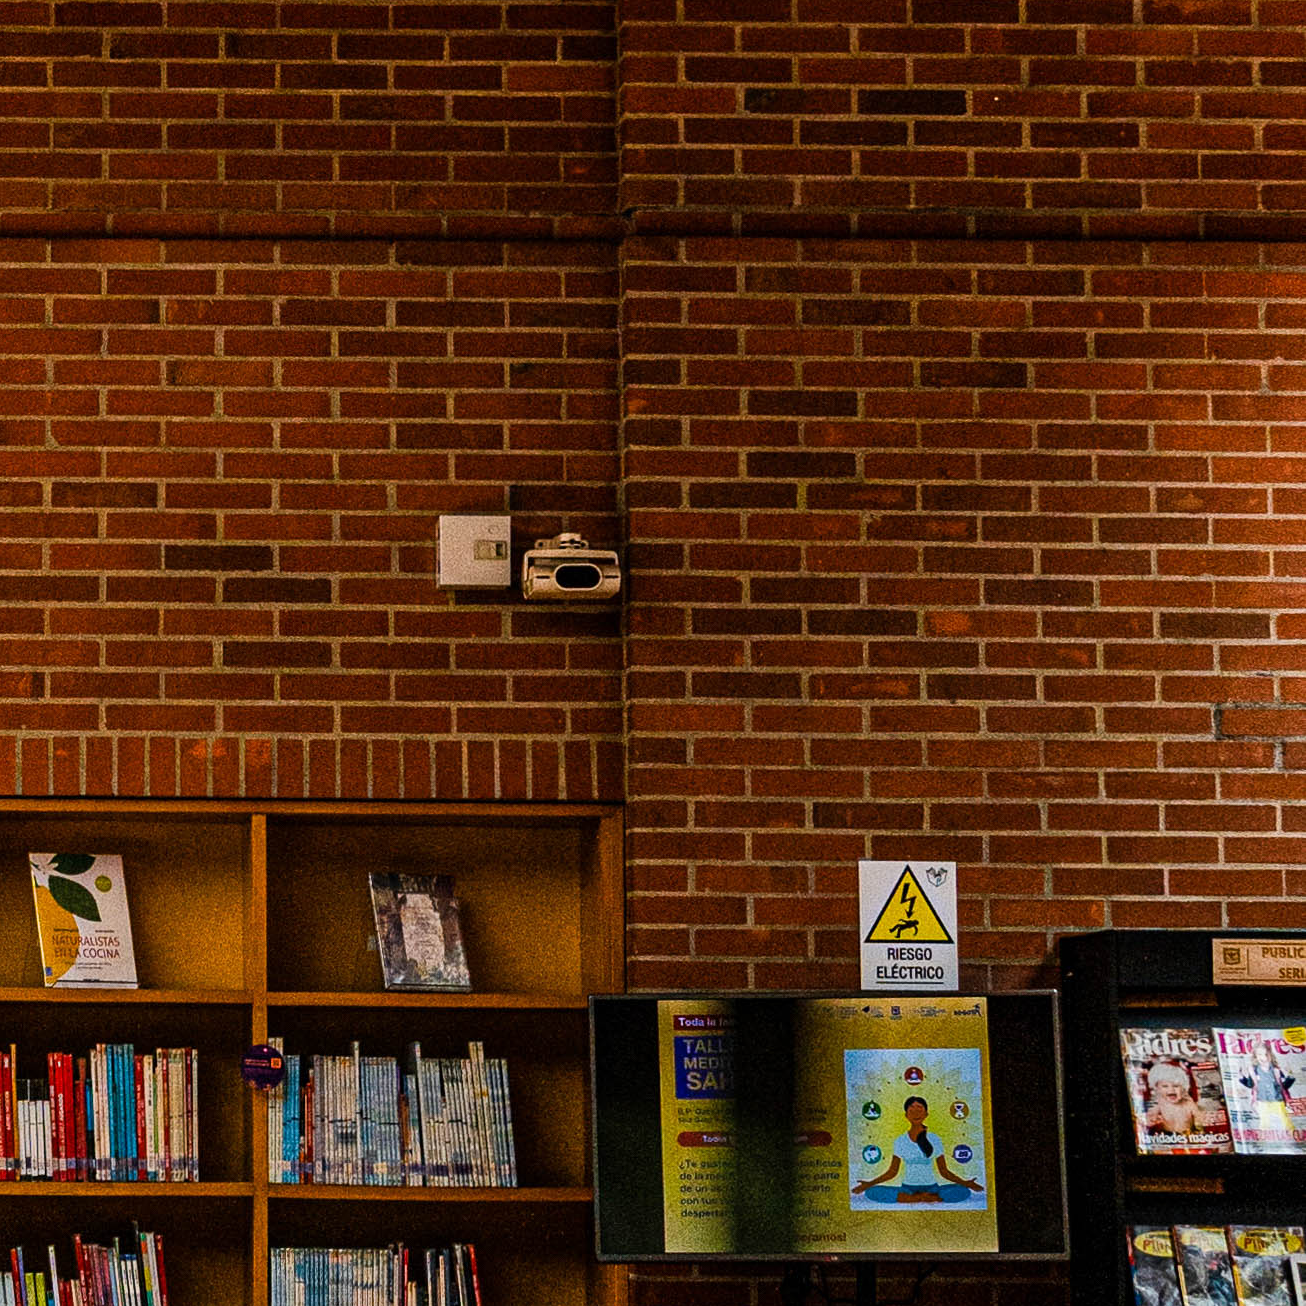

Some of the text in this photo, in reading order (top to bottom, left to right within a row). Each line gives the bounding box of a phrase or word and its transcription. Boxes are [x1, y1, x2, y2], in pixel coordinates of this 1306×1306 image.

[52, 935, 120, 947] NATURALISTAS
[82, 948, 121, 959] COCINA
[887, 948, 932, 961] RIESGO
[1261, 947, 1306, 958] PUBLIC
[876, 963, 944, 980] ELÉCTRICO
[1278, 967, 1306, 979] SERI
[678, 1017, 705, 1027] Toda
[683, 1039, 728, 1054] TALL
[1127, 1030, 1213, 1057] Padres
[684, 1057, 728, 1070] MEDI
